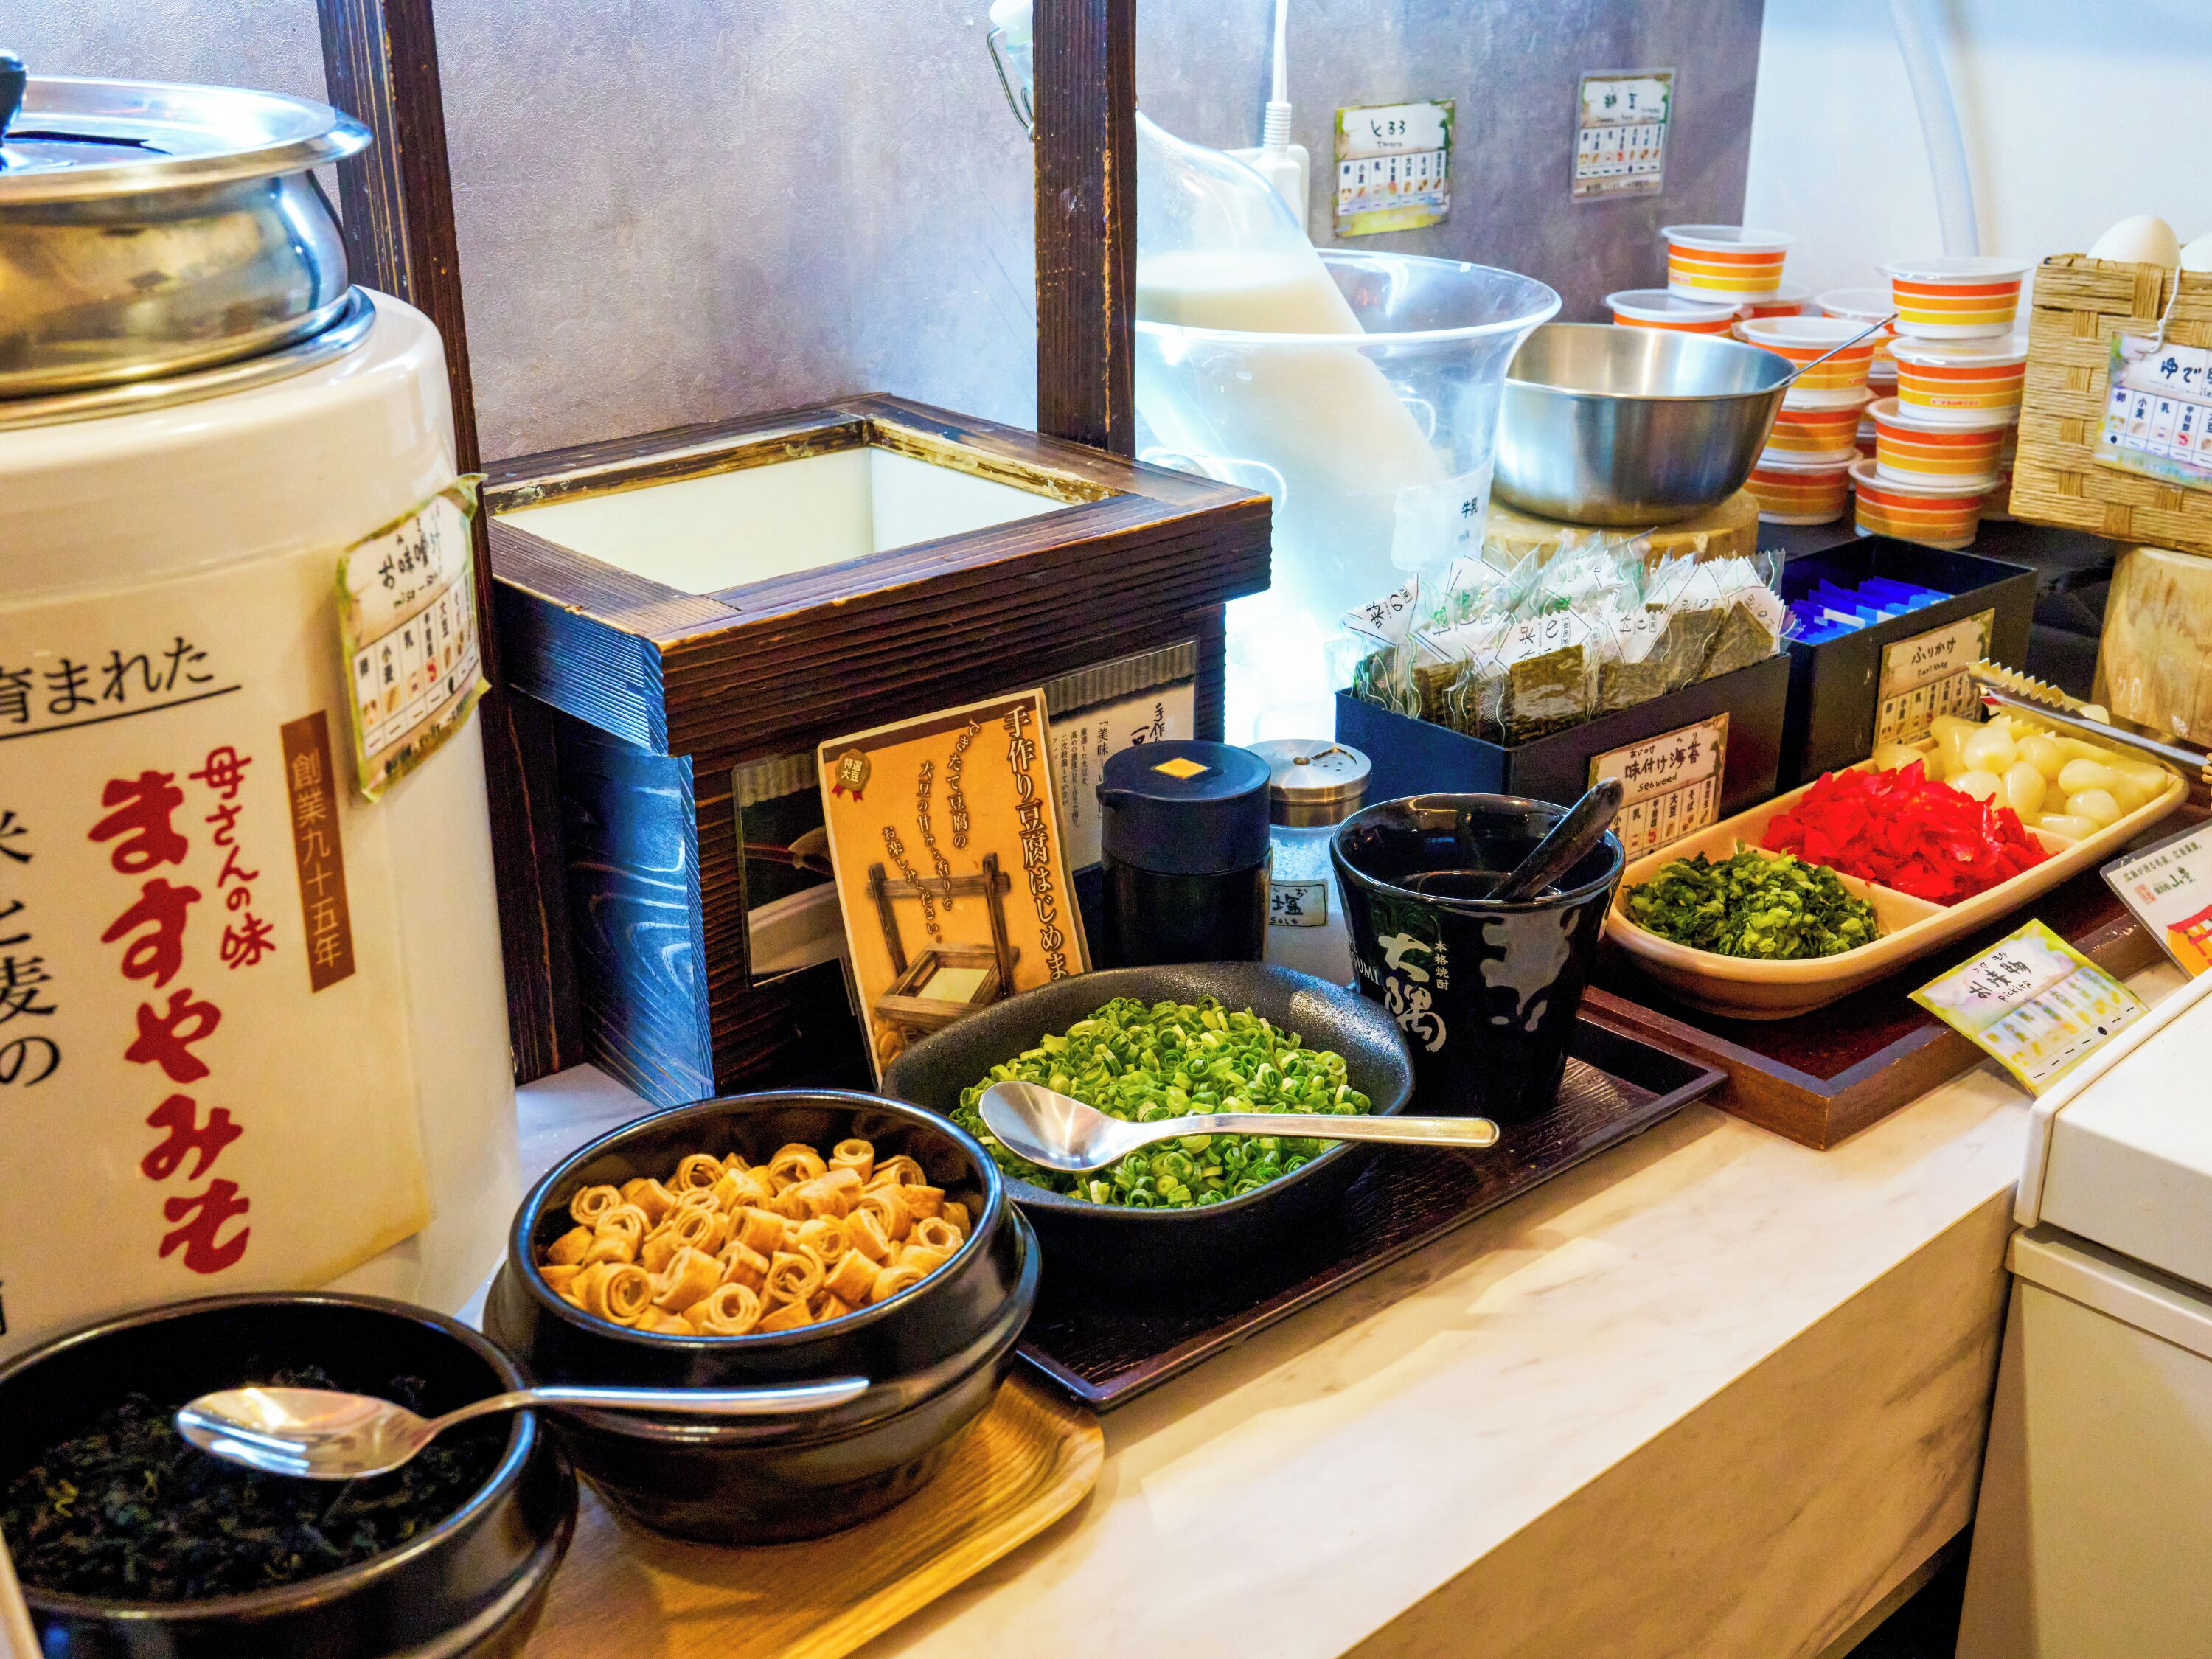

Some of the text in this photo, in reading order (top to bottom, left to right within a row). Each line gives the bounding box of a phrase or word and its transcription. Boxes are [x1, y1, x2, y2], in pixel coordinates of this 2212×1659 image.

[2135, 397, 2147, 420] 小麦
[1911, 637, 1956, 665] ふりかけ
[1149, 702, 1166, 742] 手作
[841, 769, 860, 782] 大豆
[1624, 741, 1701, 782] 味付け海苔
[947, 720, 981, 849] できたて豆腐の
[1686, 789, 1695, 813] そば
[1669, 793, 1679, 818] 大豆
[917, 760, 953, 912] 大豆の甘みと香りを
[189, 746, 276, 970] 母さんの味
[291, 750, 345, 968] 創業九十五年
[882, 826, 943, 944] お楽しみください。
[1271, 893, 1304, 916] 塩
[1434, 940, 1450, 991] 本格焼酎
[1969, 960, 2033, 1000] お漬物
[1378, 932, 1447, 1053] 大隅
[87, 770, 251, 1275] ますやみそ
